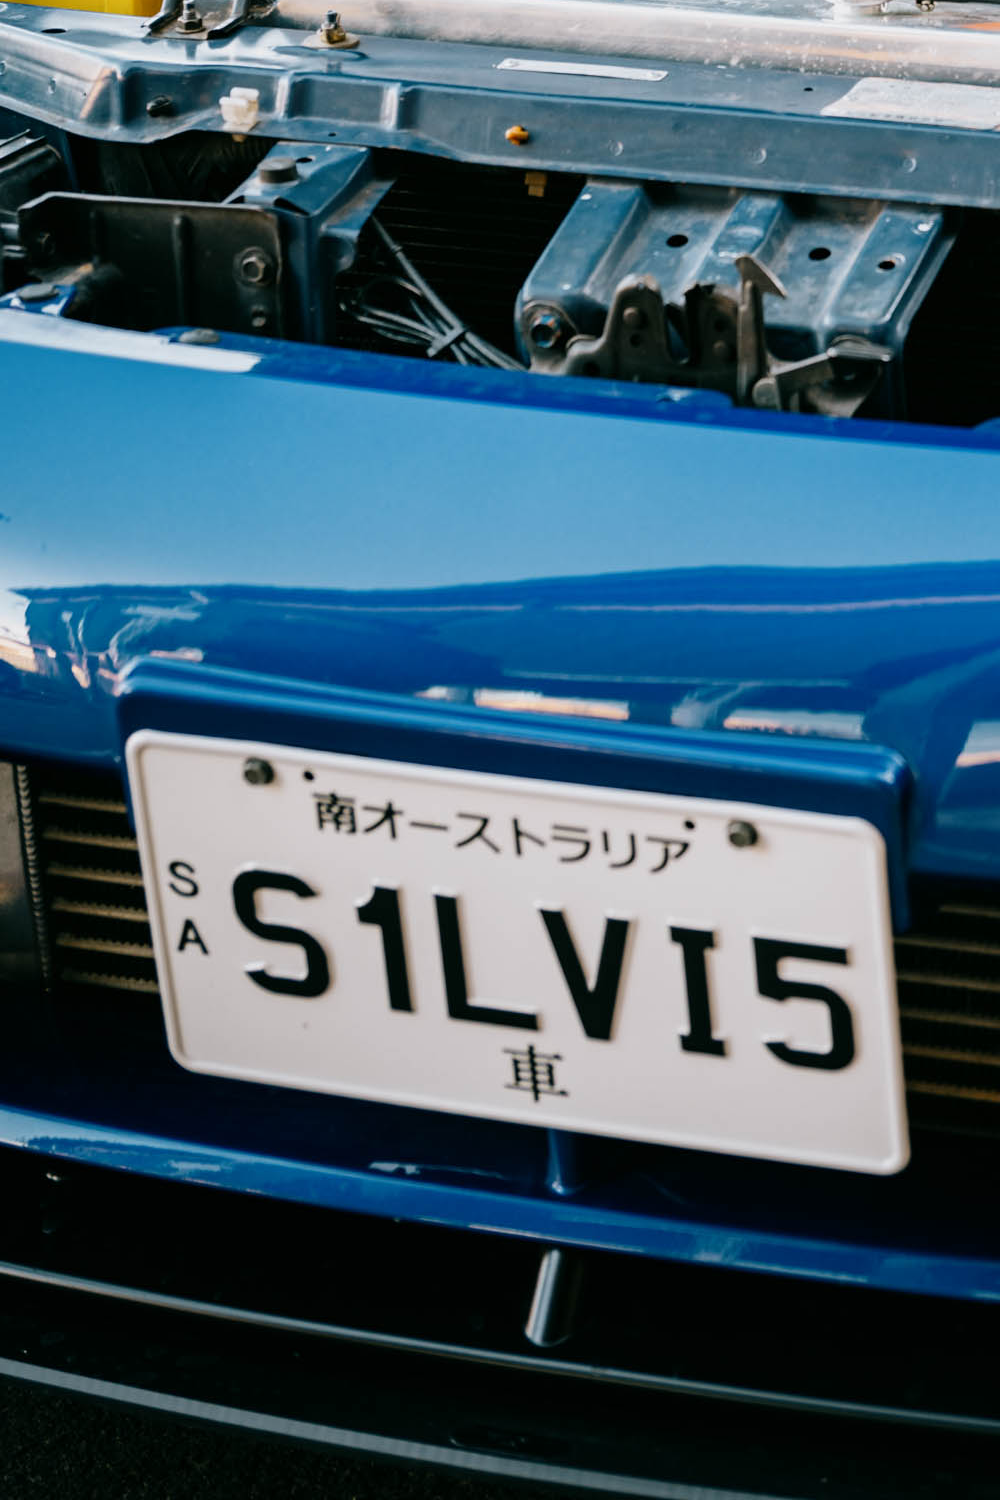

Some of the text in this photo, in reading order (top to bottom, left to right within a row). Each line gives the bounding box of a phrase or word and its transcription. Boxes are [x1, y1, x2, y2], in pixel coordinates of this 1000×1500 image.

[312, 791, 690, 873] 南オーストラリア
[231, 867, 855, 1071] S1LVI5
[502, 1043, 569, 1102] 車
